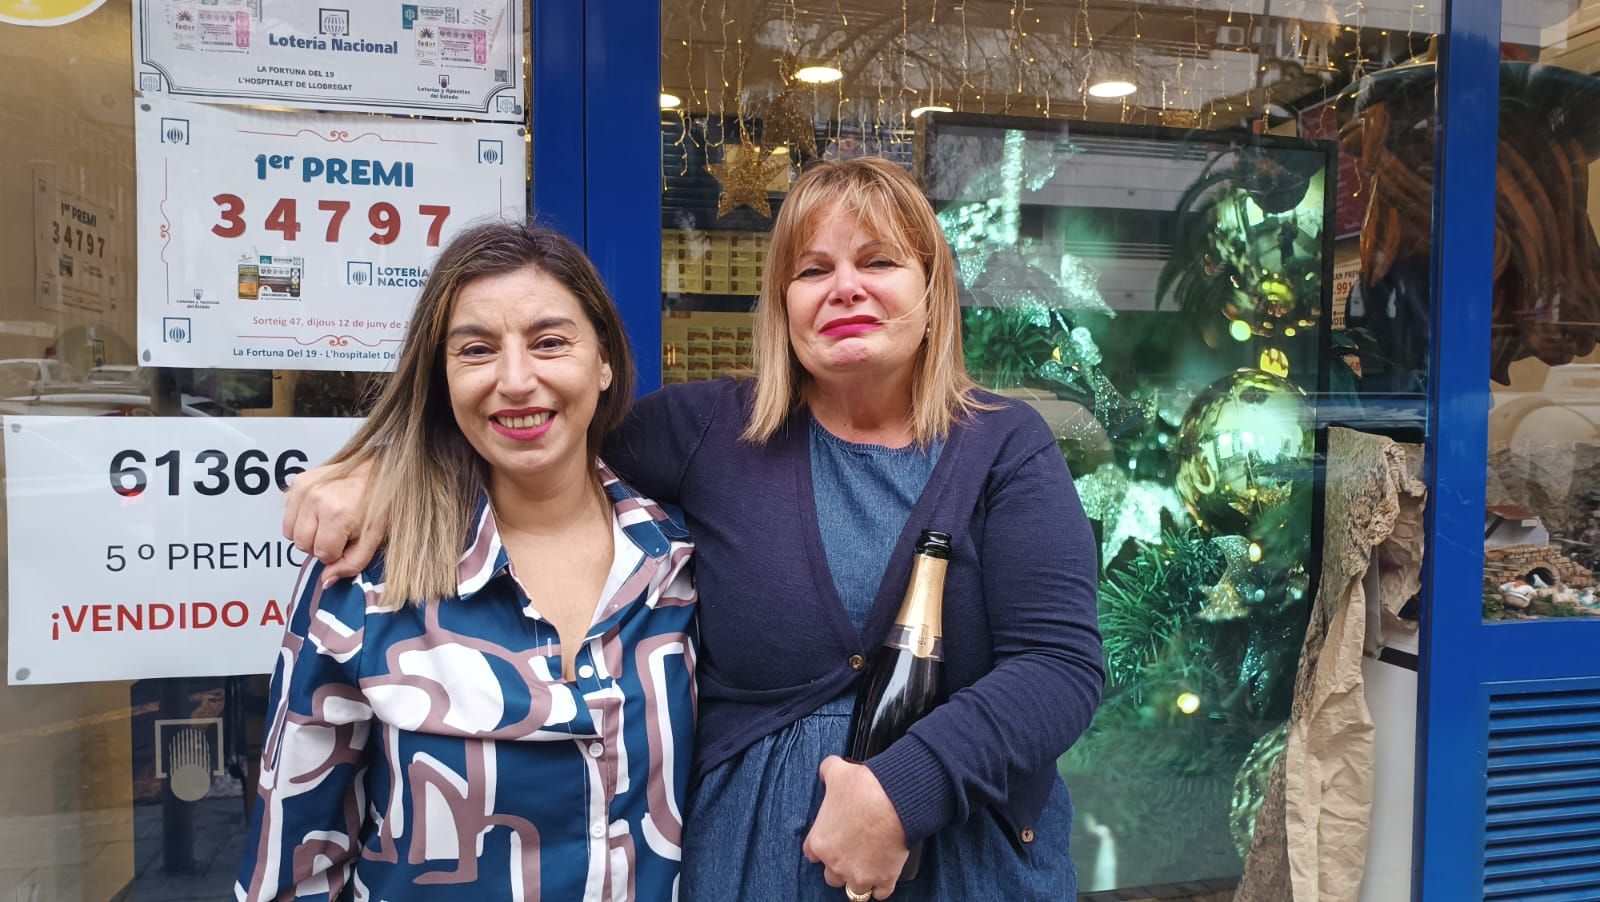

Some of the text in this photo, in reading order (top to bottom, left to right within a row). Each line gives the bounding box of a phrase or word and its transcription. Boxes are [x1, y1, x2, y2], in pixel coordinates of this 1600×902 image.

[269, 33, 398, 54] Lotería Nacional
[257, 65, 267, 73] LA
[269, 66, 306, 76] FORTUNA
[308, 70, 323, 78] DEL
[238, 77, 293, 88] L'HOSPITALET
[308, 82, 353, 91] LLOBREGAT
[255, 154, 414, 187] 1er PREMI
[72, 206, 97, 228] PREMI
[211, 193, 451, 247] 34797
[52, 221, 105, 258] 34797
[377, 277, 427, 288] NACION
[252, 316, 287, 327] Sorteig
[307, 317, 335, 328] dijous
[338, 318, 350, 327] 12
[352, 318, 365, 327] de
[366, 319, 387, 330] juny
[389, 320, 402, 329] de
[233, 348, 244, 356] La
[246, 348, 285, 357] Fortuna
[287, 349, 303, 358] Del
[305, 349, 317, 358] 19
[326, 349, 380, 361] L'hospitalet
[383, 351, 396, 360] De
[109, 449, 309, 497] 61366
[106, 545, 126, 571] 5
[51, 600, 249, 641] ¡VENDIDO
